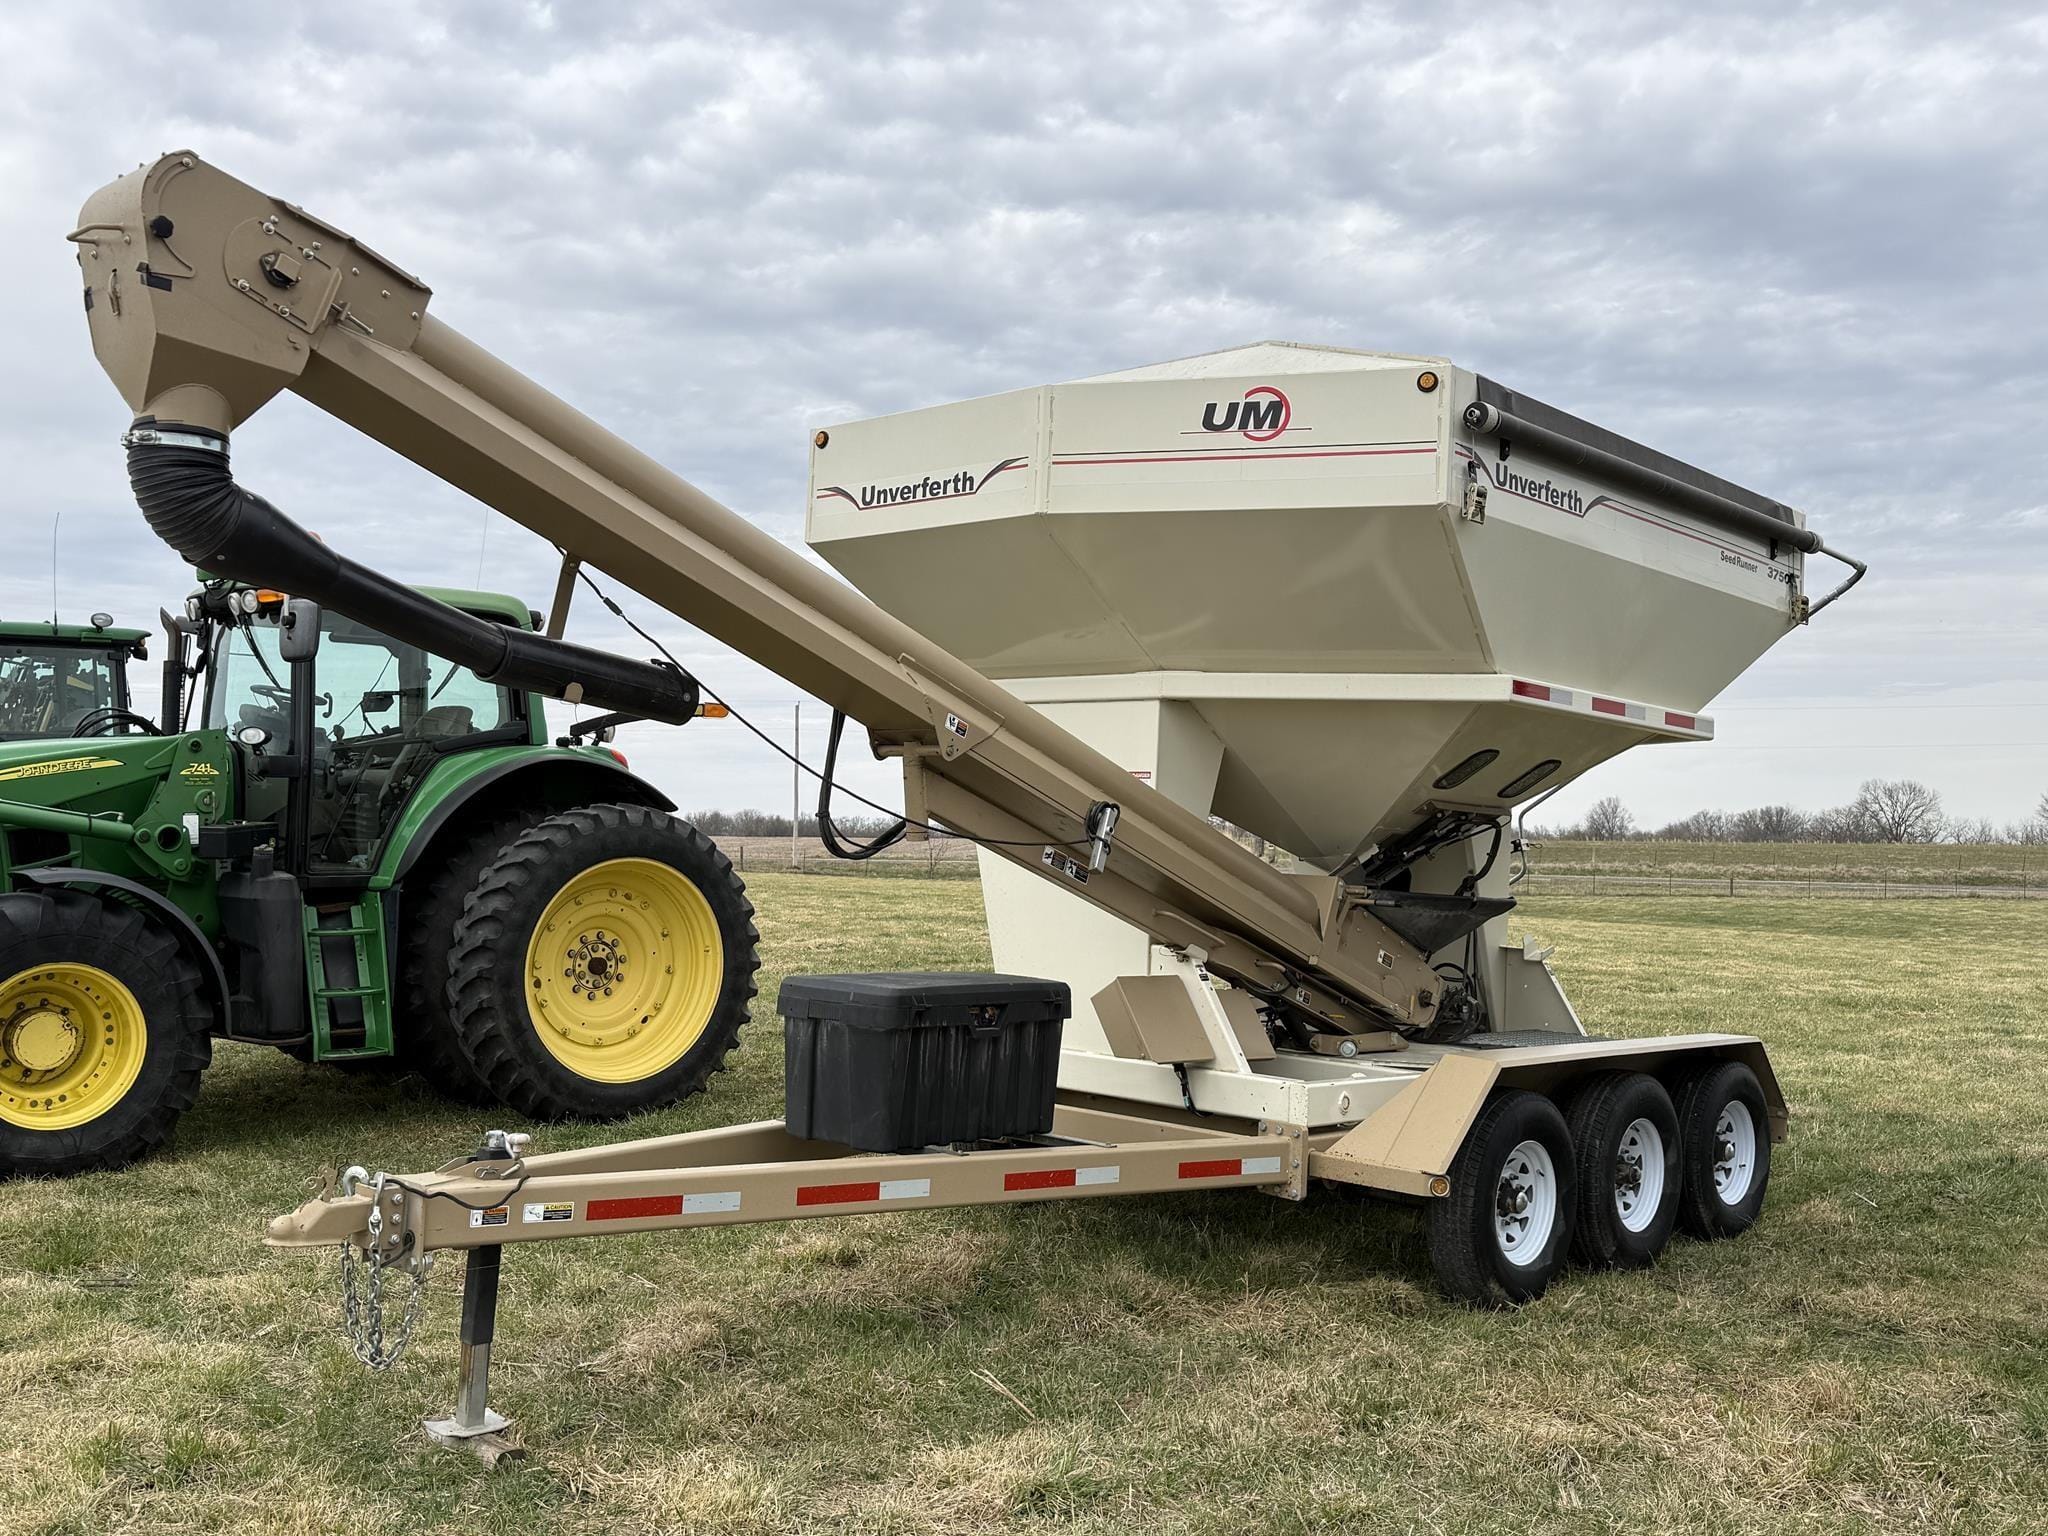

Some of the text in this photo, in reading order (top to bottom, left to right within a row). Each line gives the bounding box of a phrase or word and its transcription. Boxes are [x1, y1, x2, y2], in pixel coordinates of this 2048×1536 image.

[1202, 400, 1284, 431] UM
[861, 471, 975, 506] Unverferth
[1495, 462, 1583, 513] Unverferth
[1720, 550, 1758, 573] Seed Runner
[1767, 566, 1791, 585] 3750
[17, 760, 92, 777] JOHN DEERE
[189, 762, 212, 774] 741
